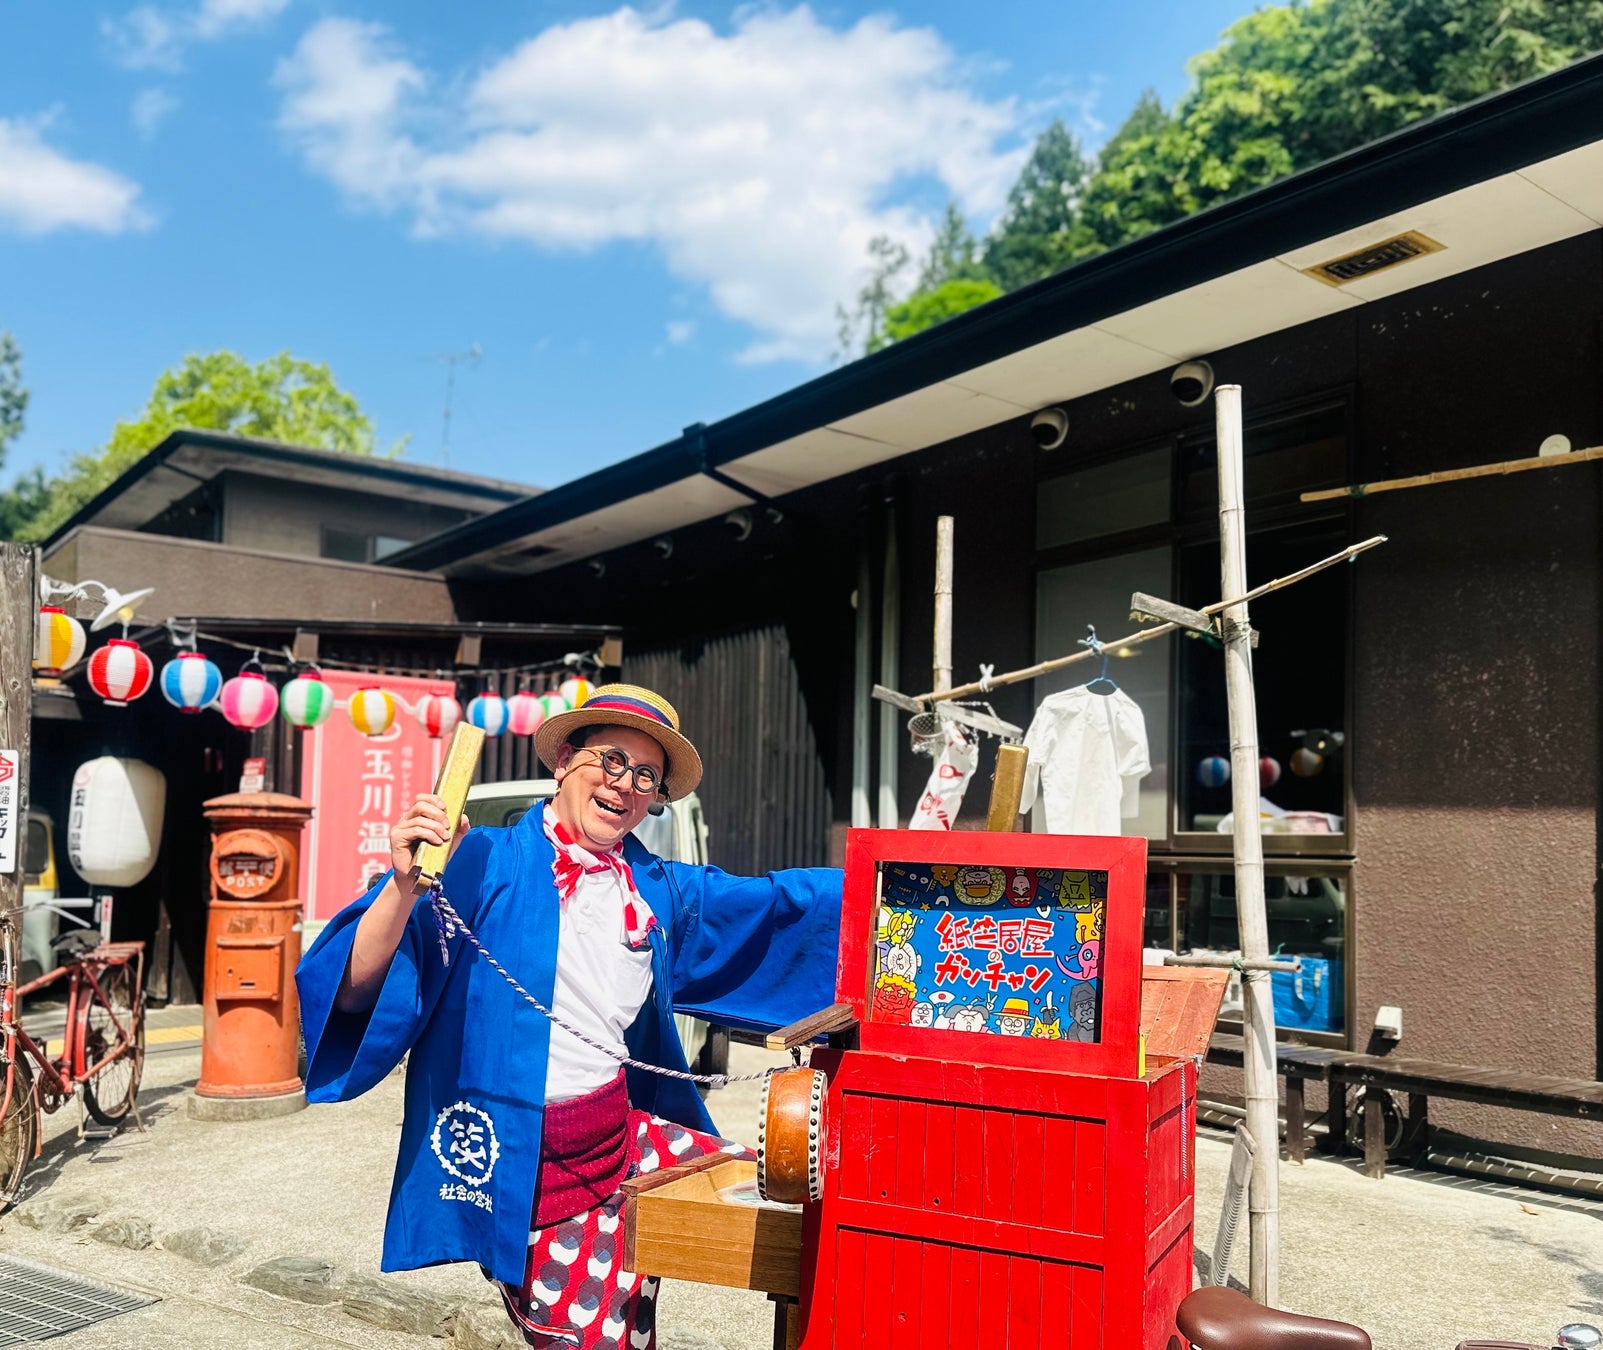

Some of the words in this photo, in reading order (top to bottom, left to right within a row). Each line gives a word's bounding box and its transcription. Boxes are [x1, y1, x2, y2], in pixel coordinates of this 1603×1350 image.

[355, 749, 395, 893] 玉川温泉
[226, 875, 266, 889] POST
[935, 911, 1055, 958] 紙芝居屋
[988, 950, 1001, 962] の
[935, 952, 1053, 994] ガンチャン
[448, 1118, 487, 1170] 笑
